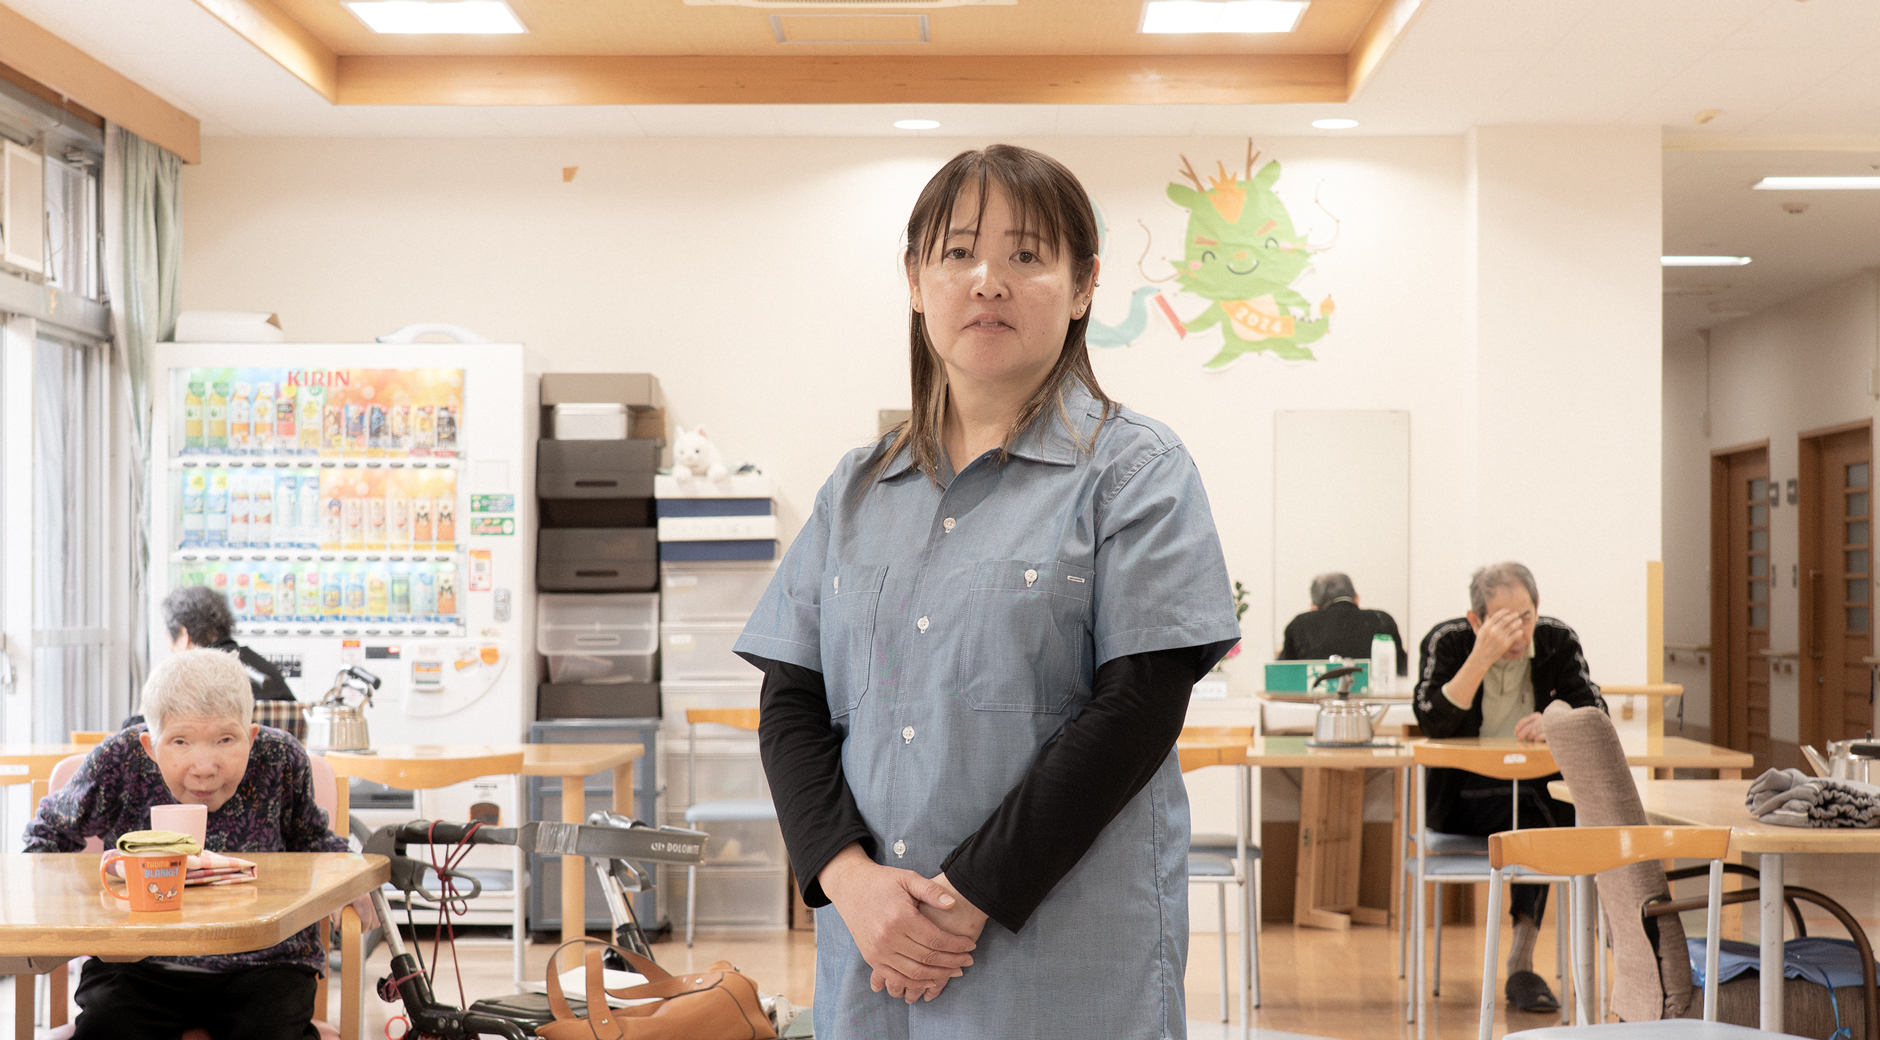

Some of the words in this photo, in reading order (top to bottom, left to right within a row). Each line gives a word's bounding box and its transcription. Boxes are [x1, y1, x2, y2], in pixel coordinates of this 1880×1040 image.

[1235, 307, 1282, 333] 2024
[288, 370, 350, 387] KIRIN
[144, 867, 179, 878] BLANKET
